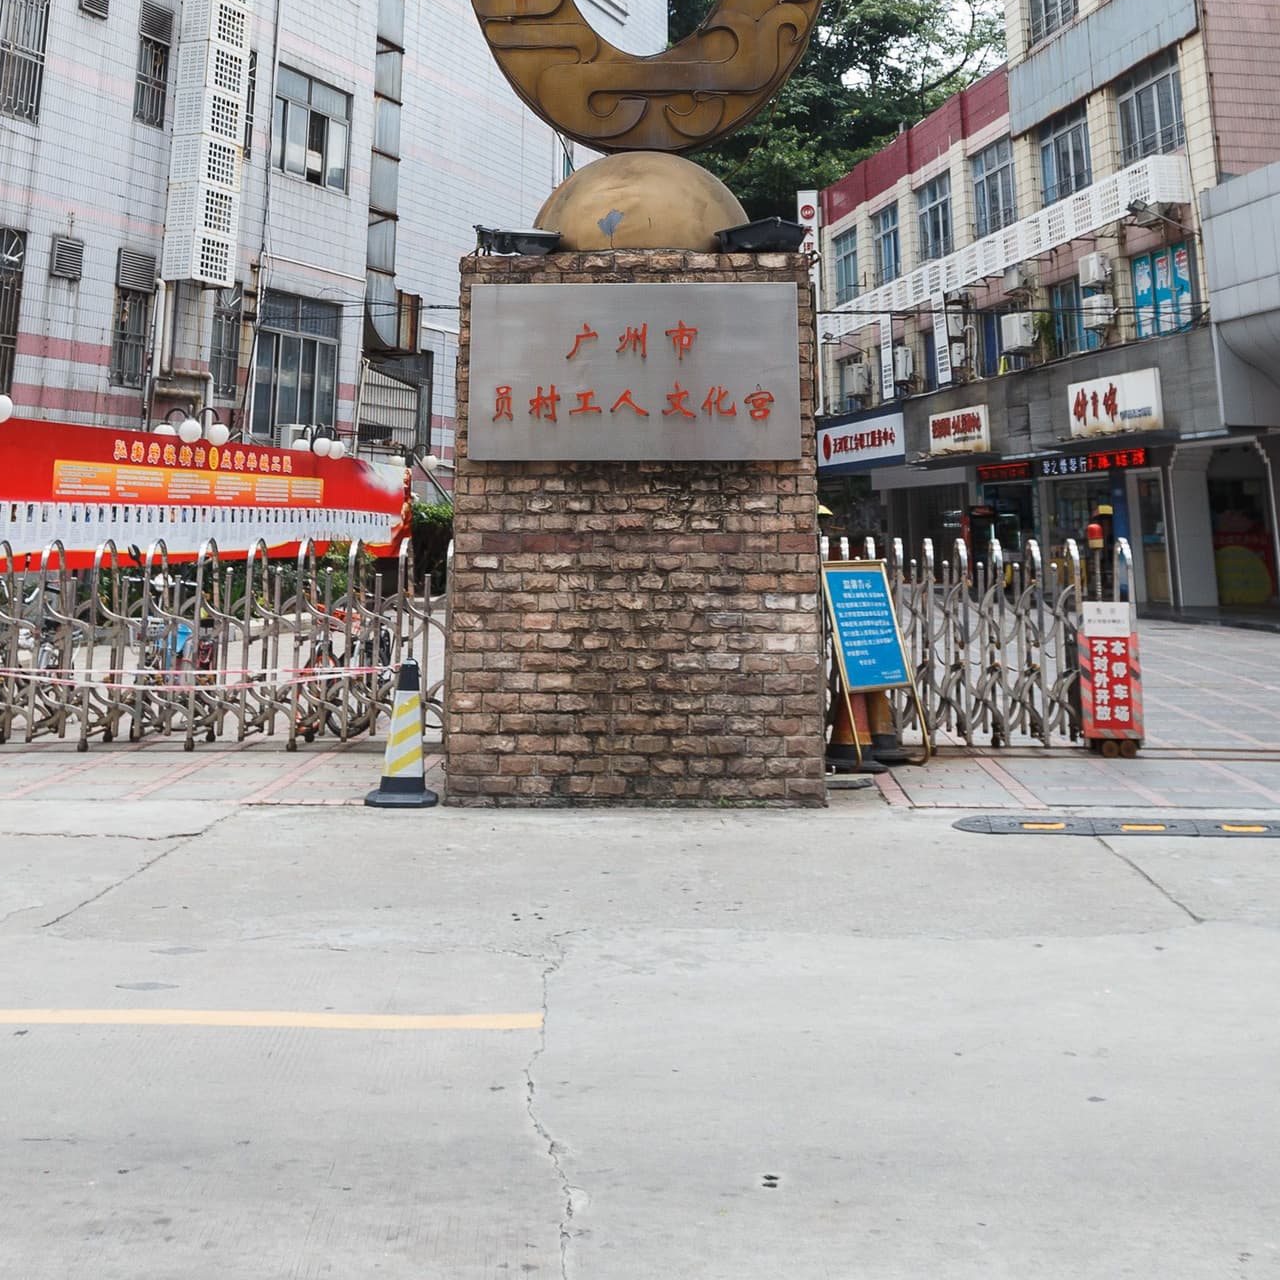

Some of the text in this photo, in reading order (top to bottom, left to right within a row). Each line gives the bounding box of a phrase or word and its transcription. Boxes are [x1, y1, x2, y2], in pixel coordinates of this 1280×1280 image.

[565, 320, 698, 361] 广州市
[492, 383, 775, 422] 员村工人文化宫
[1092, 639, 1111, 722] 不对外开放
[1110, 640, 1130, 722] 本停车场
